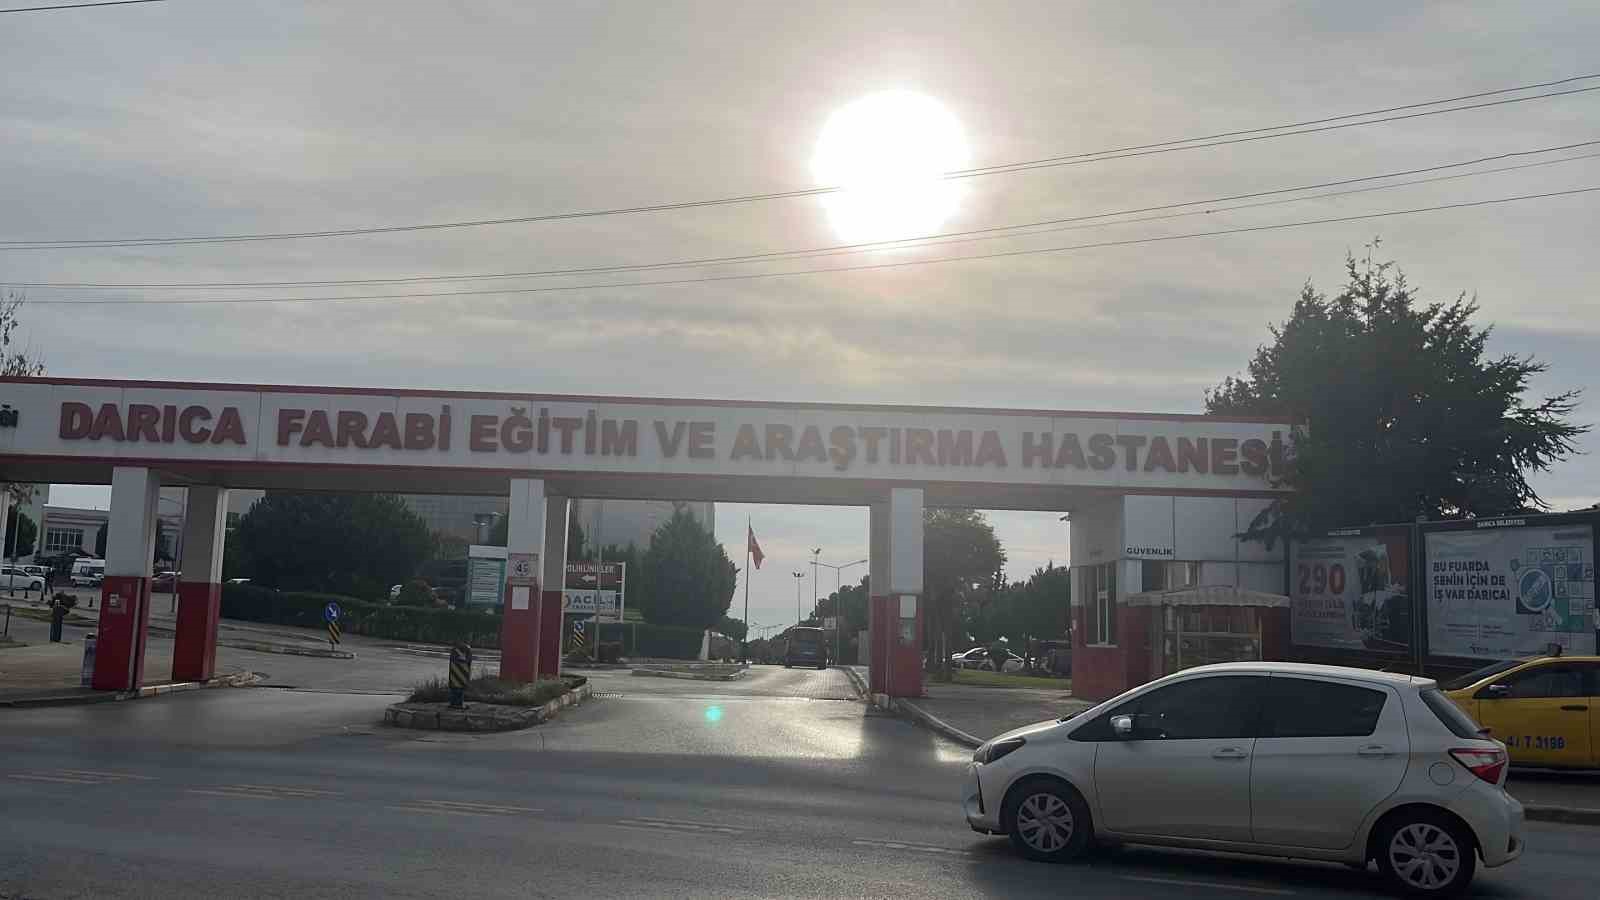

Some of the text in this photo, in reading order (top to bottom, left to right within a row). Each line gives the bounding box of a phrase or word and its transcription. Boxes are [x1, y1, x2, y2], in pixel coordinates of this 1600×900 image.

[60, 402, 1282, 476] DARICA FARABİ EĞİTİM VE ARAŞTIRMA HASTANESİ
[1433, 560, 1490, 572] BU FUARDA
[1297, 562, 1345, 594] 290
[1433, 573, 1506, 590] SENİN İÇİN DE
[1445, 588, 1467, 600] VAR
